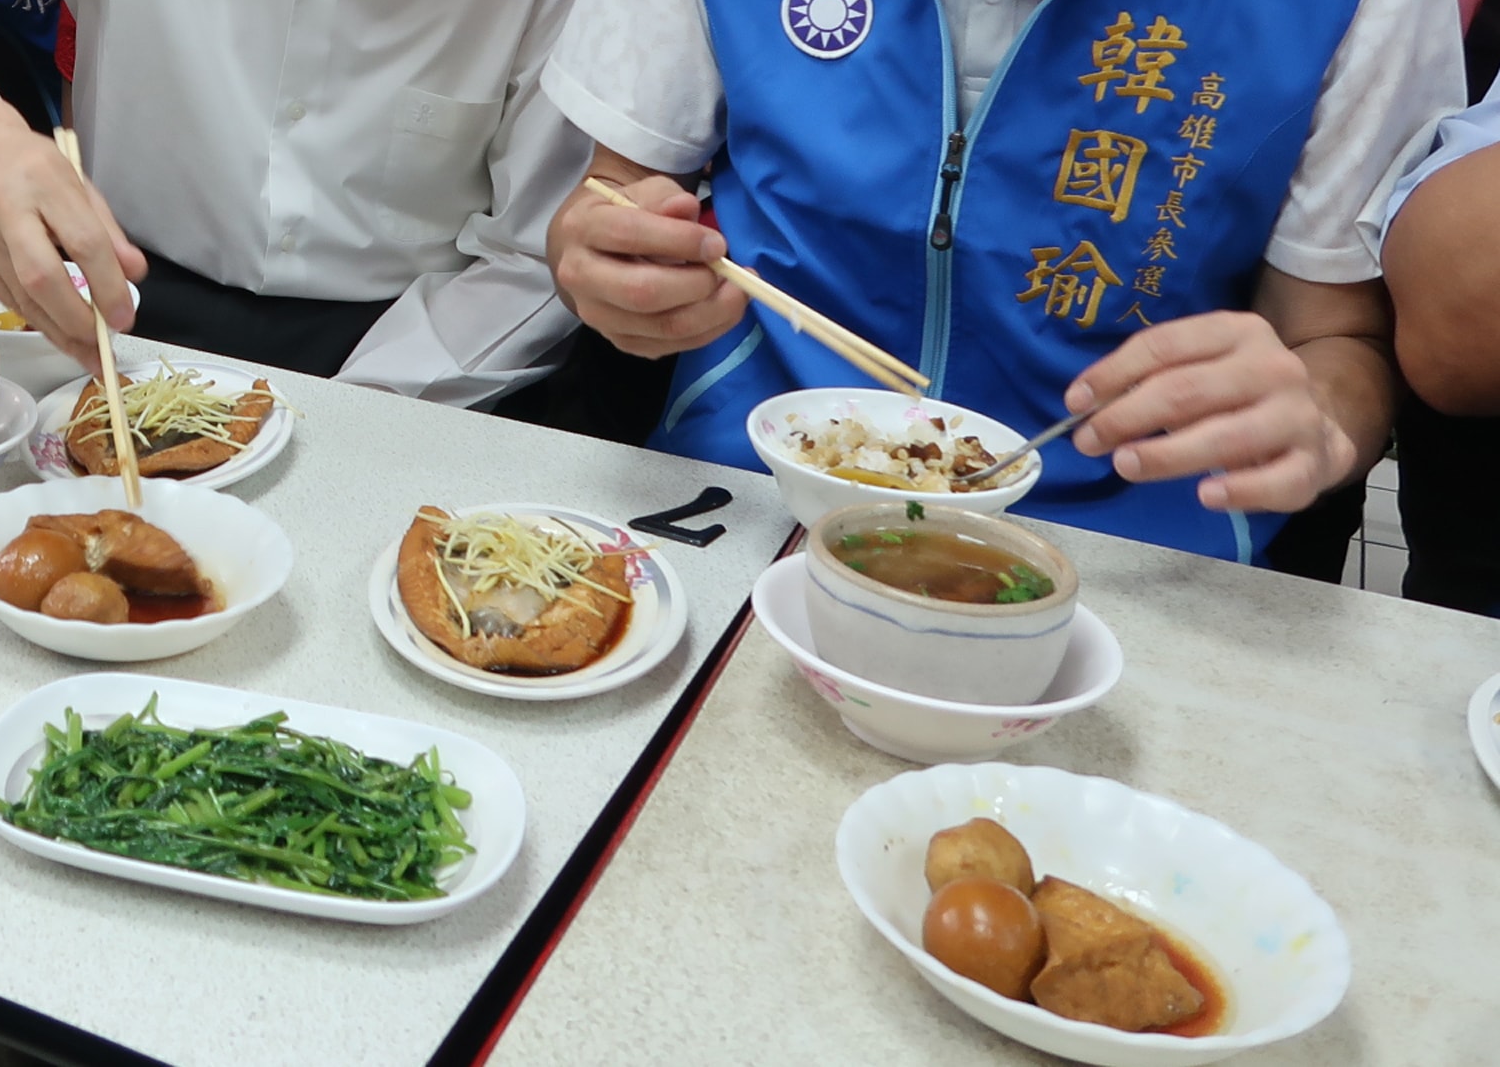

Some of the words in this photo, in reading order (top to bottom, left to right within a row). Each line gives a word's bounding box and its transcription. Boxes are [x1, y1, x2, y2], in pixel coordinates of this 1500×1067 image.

[1015, 11, 1188, 329] 韓國瑜
[1115, 72, 1227, 327] 高雄市長參選人
